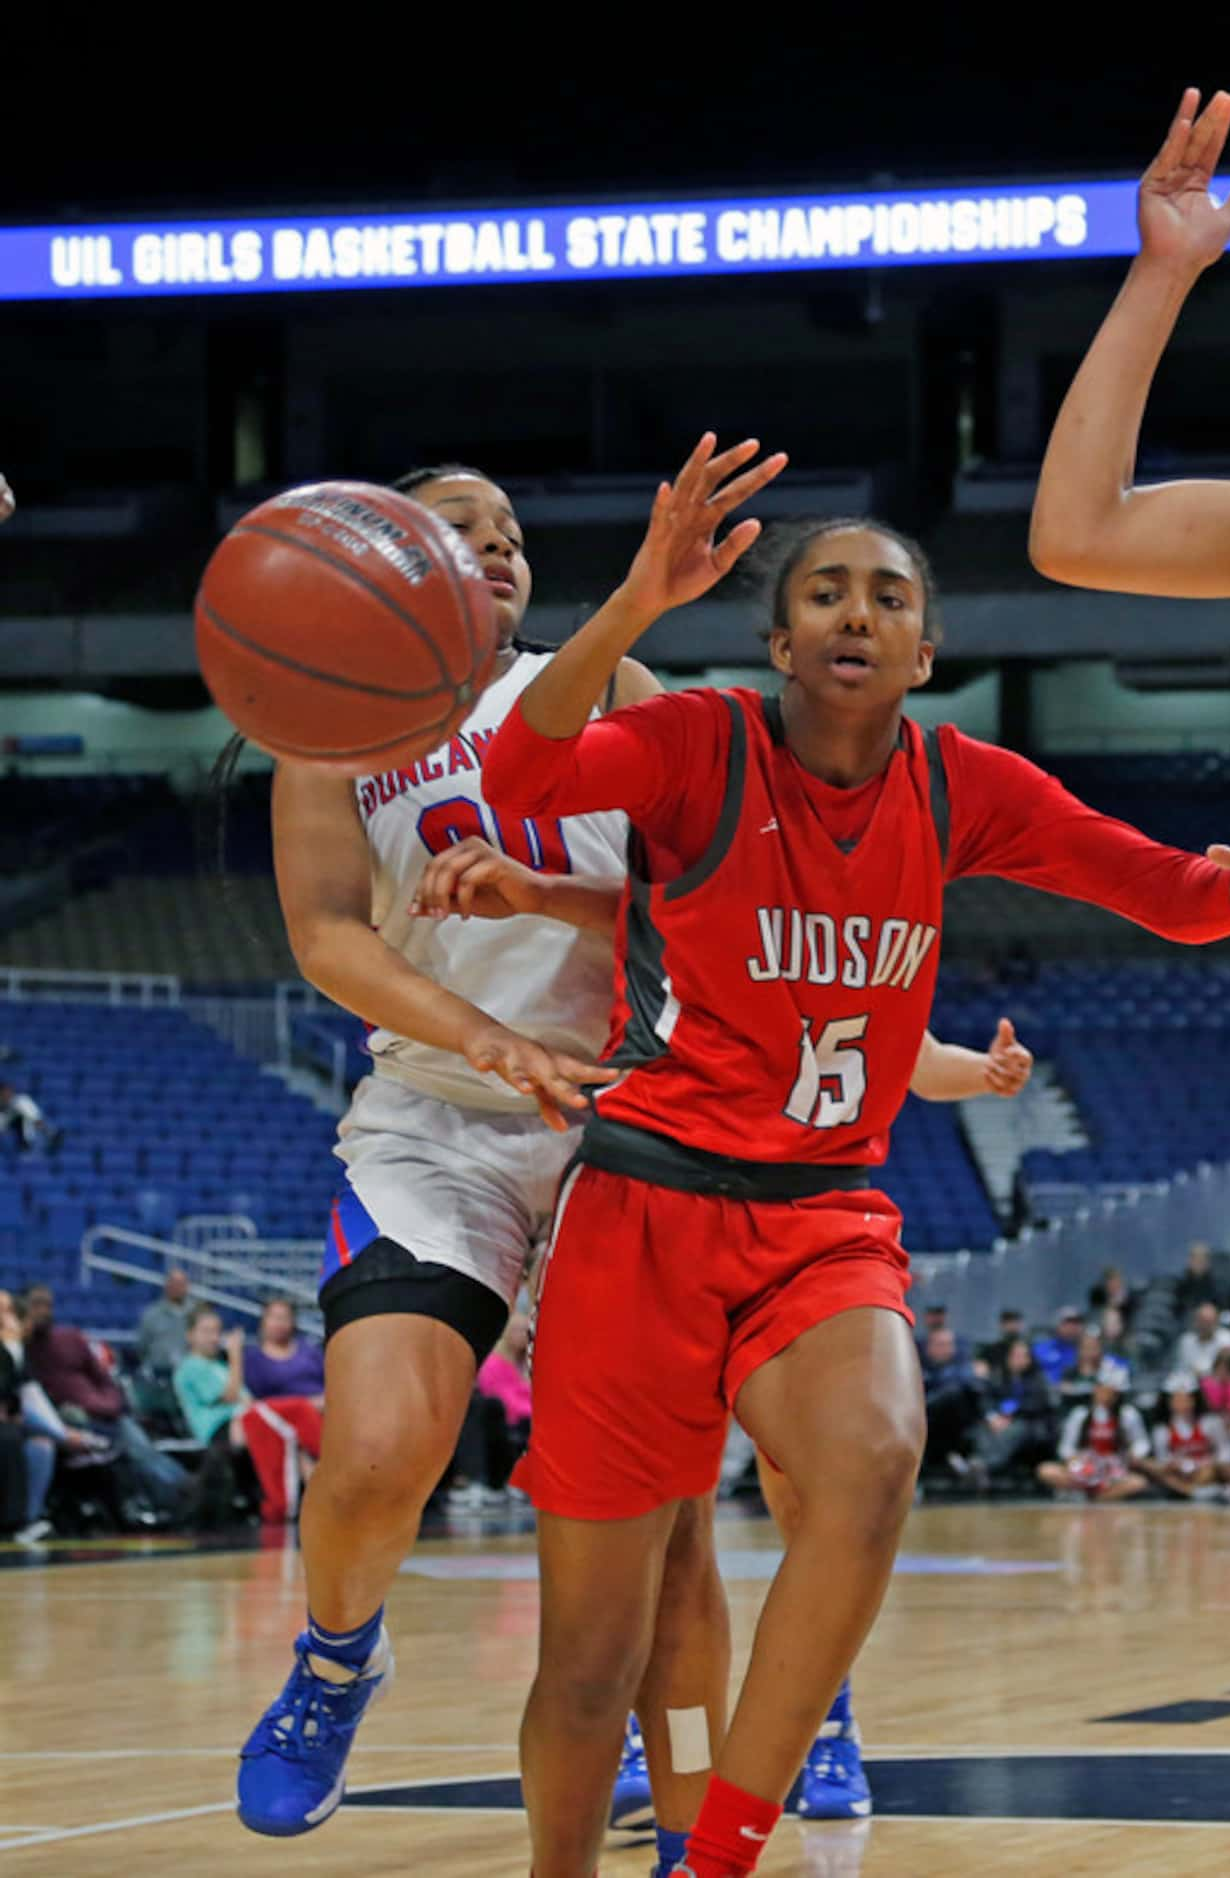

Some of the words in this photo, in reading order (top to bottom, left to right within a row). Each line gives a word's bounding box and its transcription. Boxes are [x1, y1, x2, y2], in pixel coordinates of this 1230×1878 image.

[51, 236, 121, 286] UIL
[133, 231, 262, 284] GIRLS
[273, 220, 555, 279] BASKETBALL
[567, 212, 706, 268] STATE
[717, 194, 1088, 261] CHAMPIONSHIPS
[747, 905, 938, 991] JUDSON
[782, 1011, 870, 1129] 15
